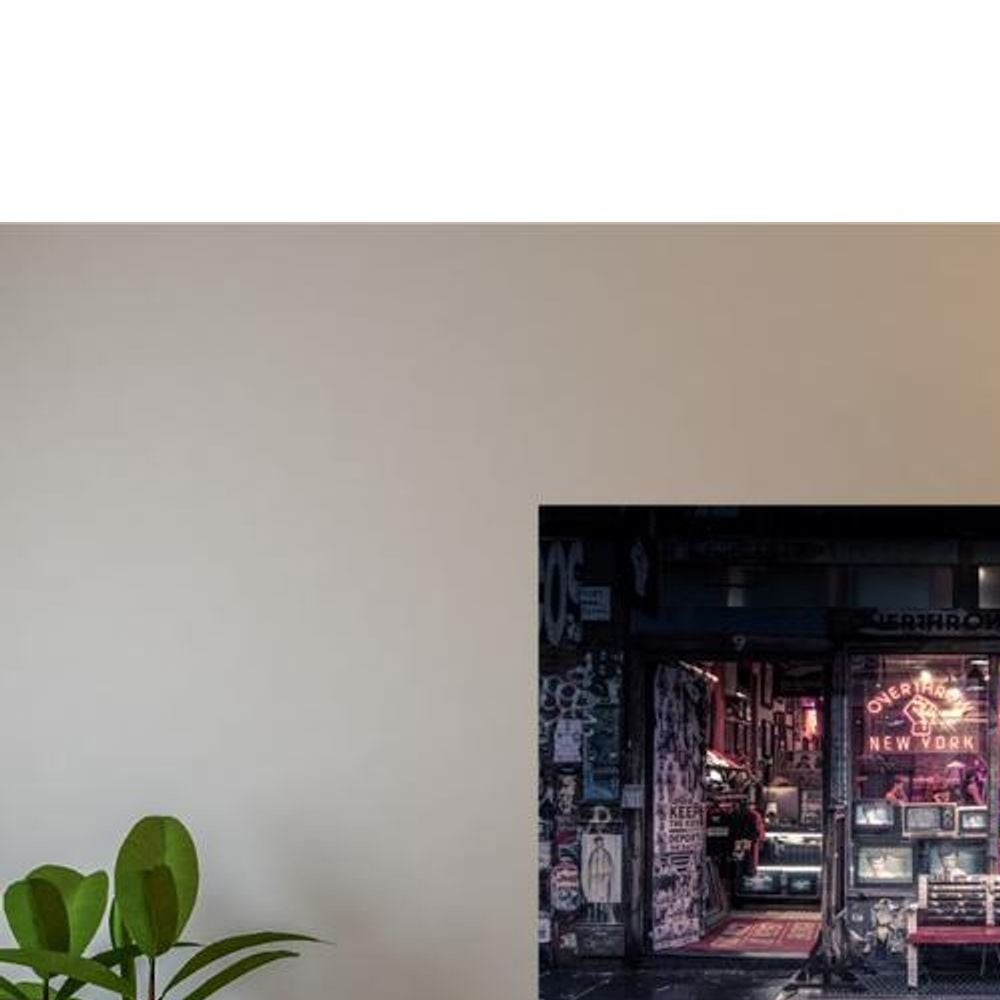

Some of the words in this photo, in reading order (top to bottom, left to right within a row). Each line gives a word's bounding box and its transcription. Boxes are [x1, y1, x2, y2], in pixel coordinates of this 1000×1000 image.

[866, 681, 975, 714] OVERTHR
[869, 735, 911, 752] NEW
[921, 735, 975, 751] YORK
